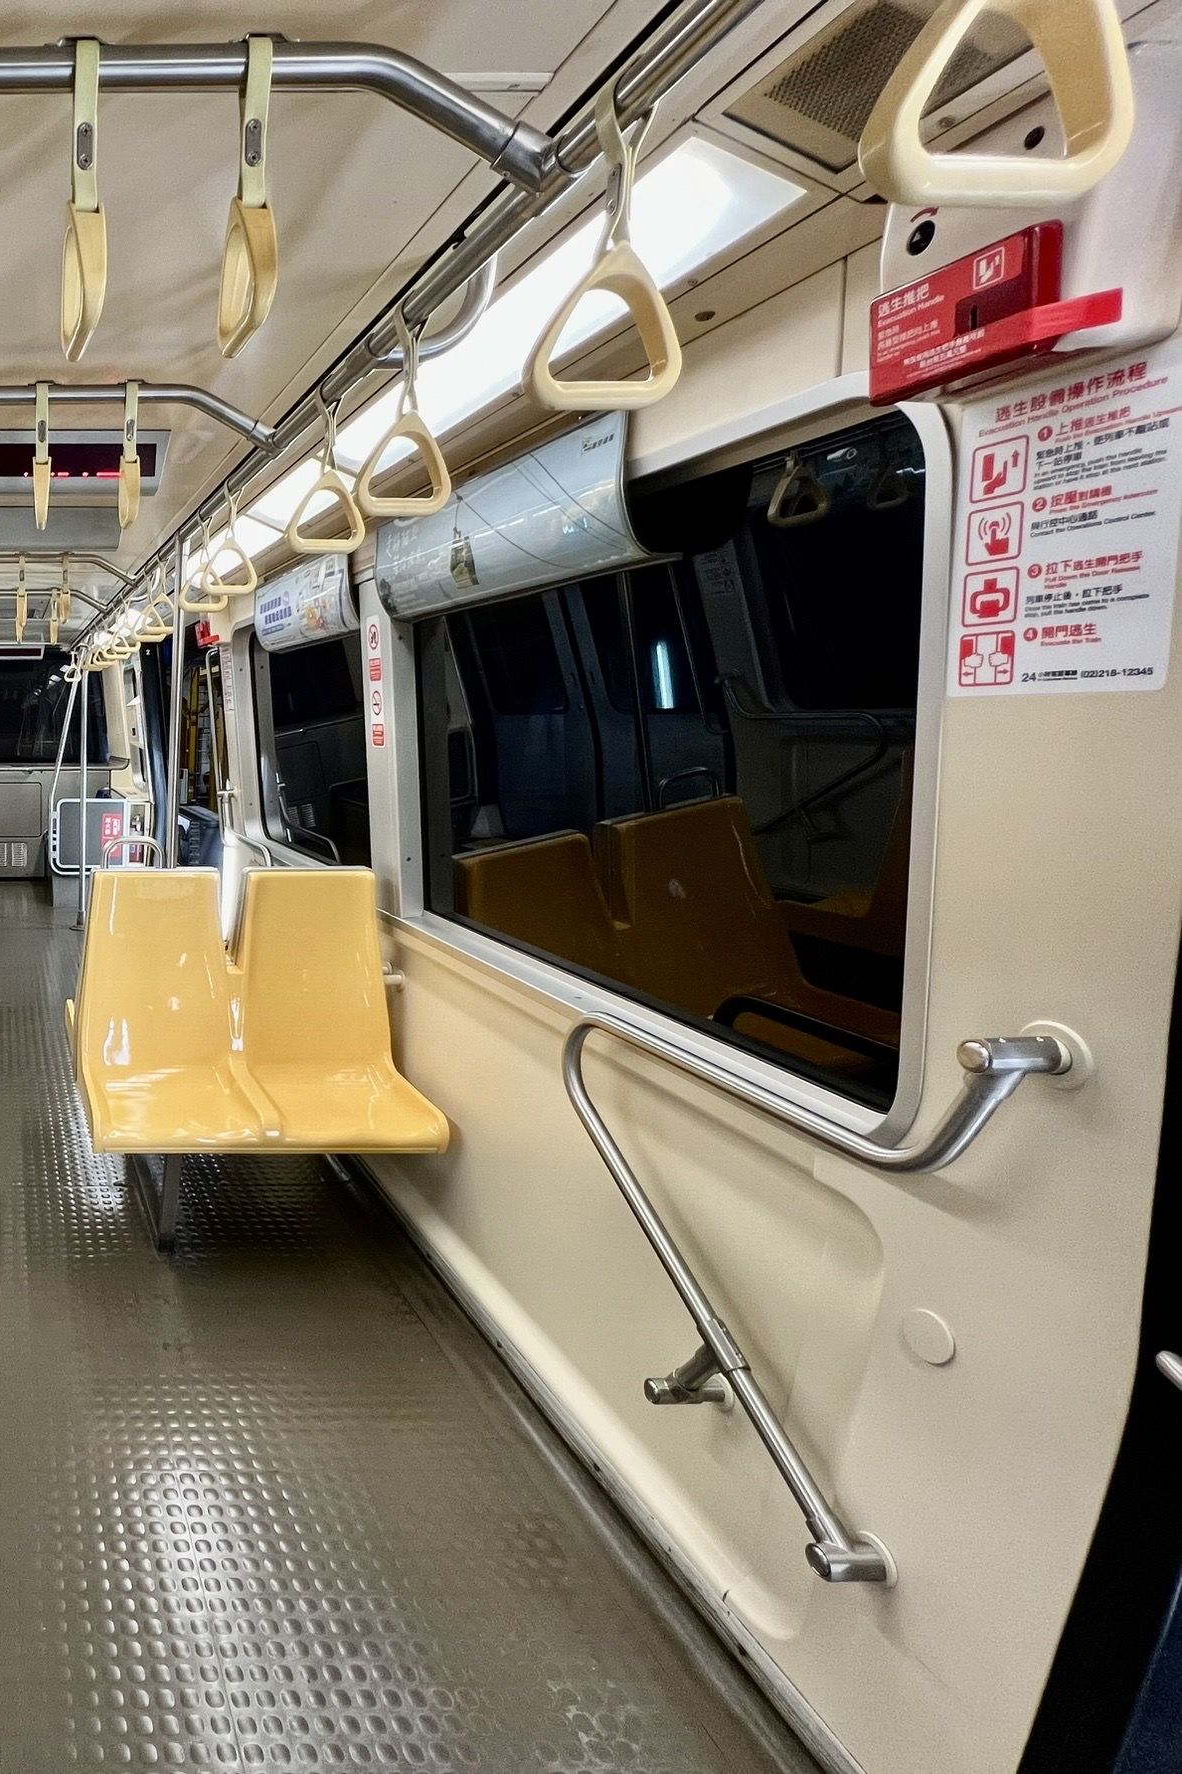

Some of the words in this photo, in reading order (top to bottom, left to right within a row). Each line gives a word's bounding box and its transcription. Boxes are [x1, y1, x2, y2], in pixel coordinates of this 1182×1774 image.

[978, 419, 1025, 437] Evacuation
[1027, 409, 1058, 424] Handle
[1061, 395, 1110, 413] Operation
[1112, 376, 1168, 398] Procedure
[995, 361, 1147, 422] 逃生設備操作流程
[1041, 623, 1097, 639] 開門逃生
[1021, 672, 1036, 682] 24
[1080, 667, 1154, 678] (02)218-12345
